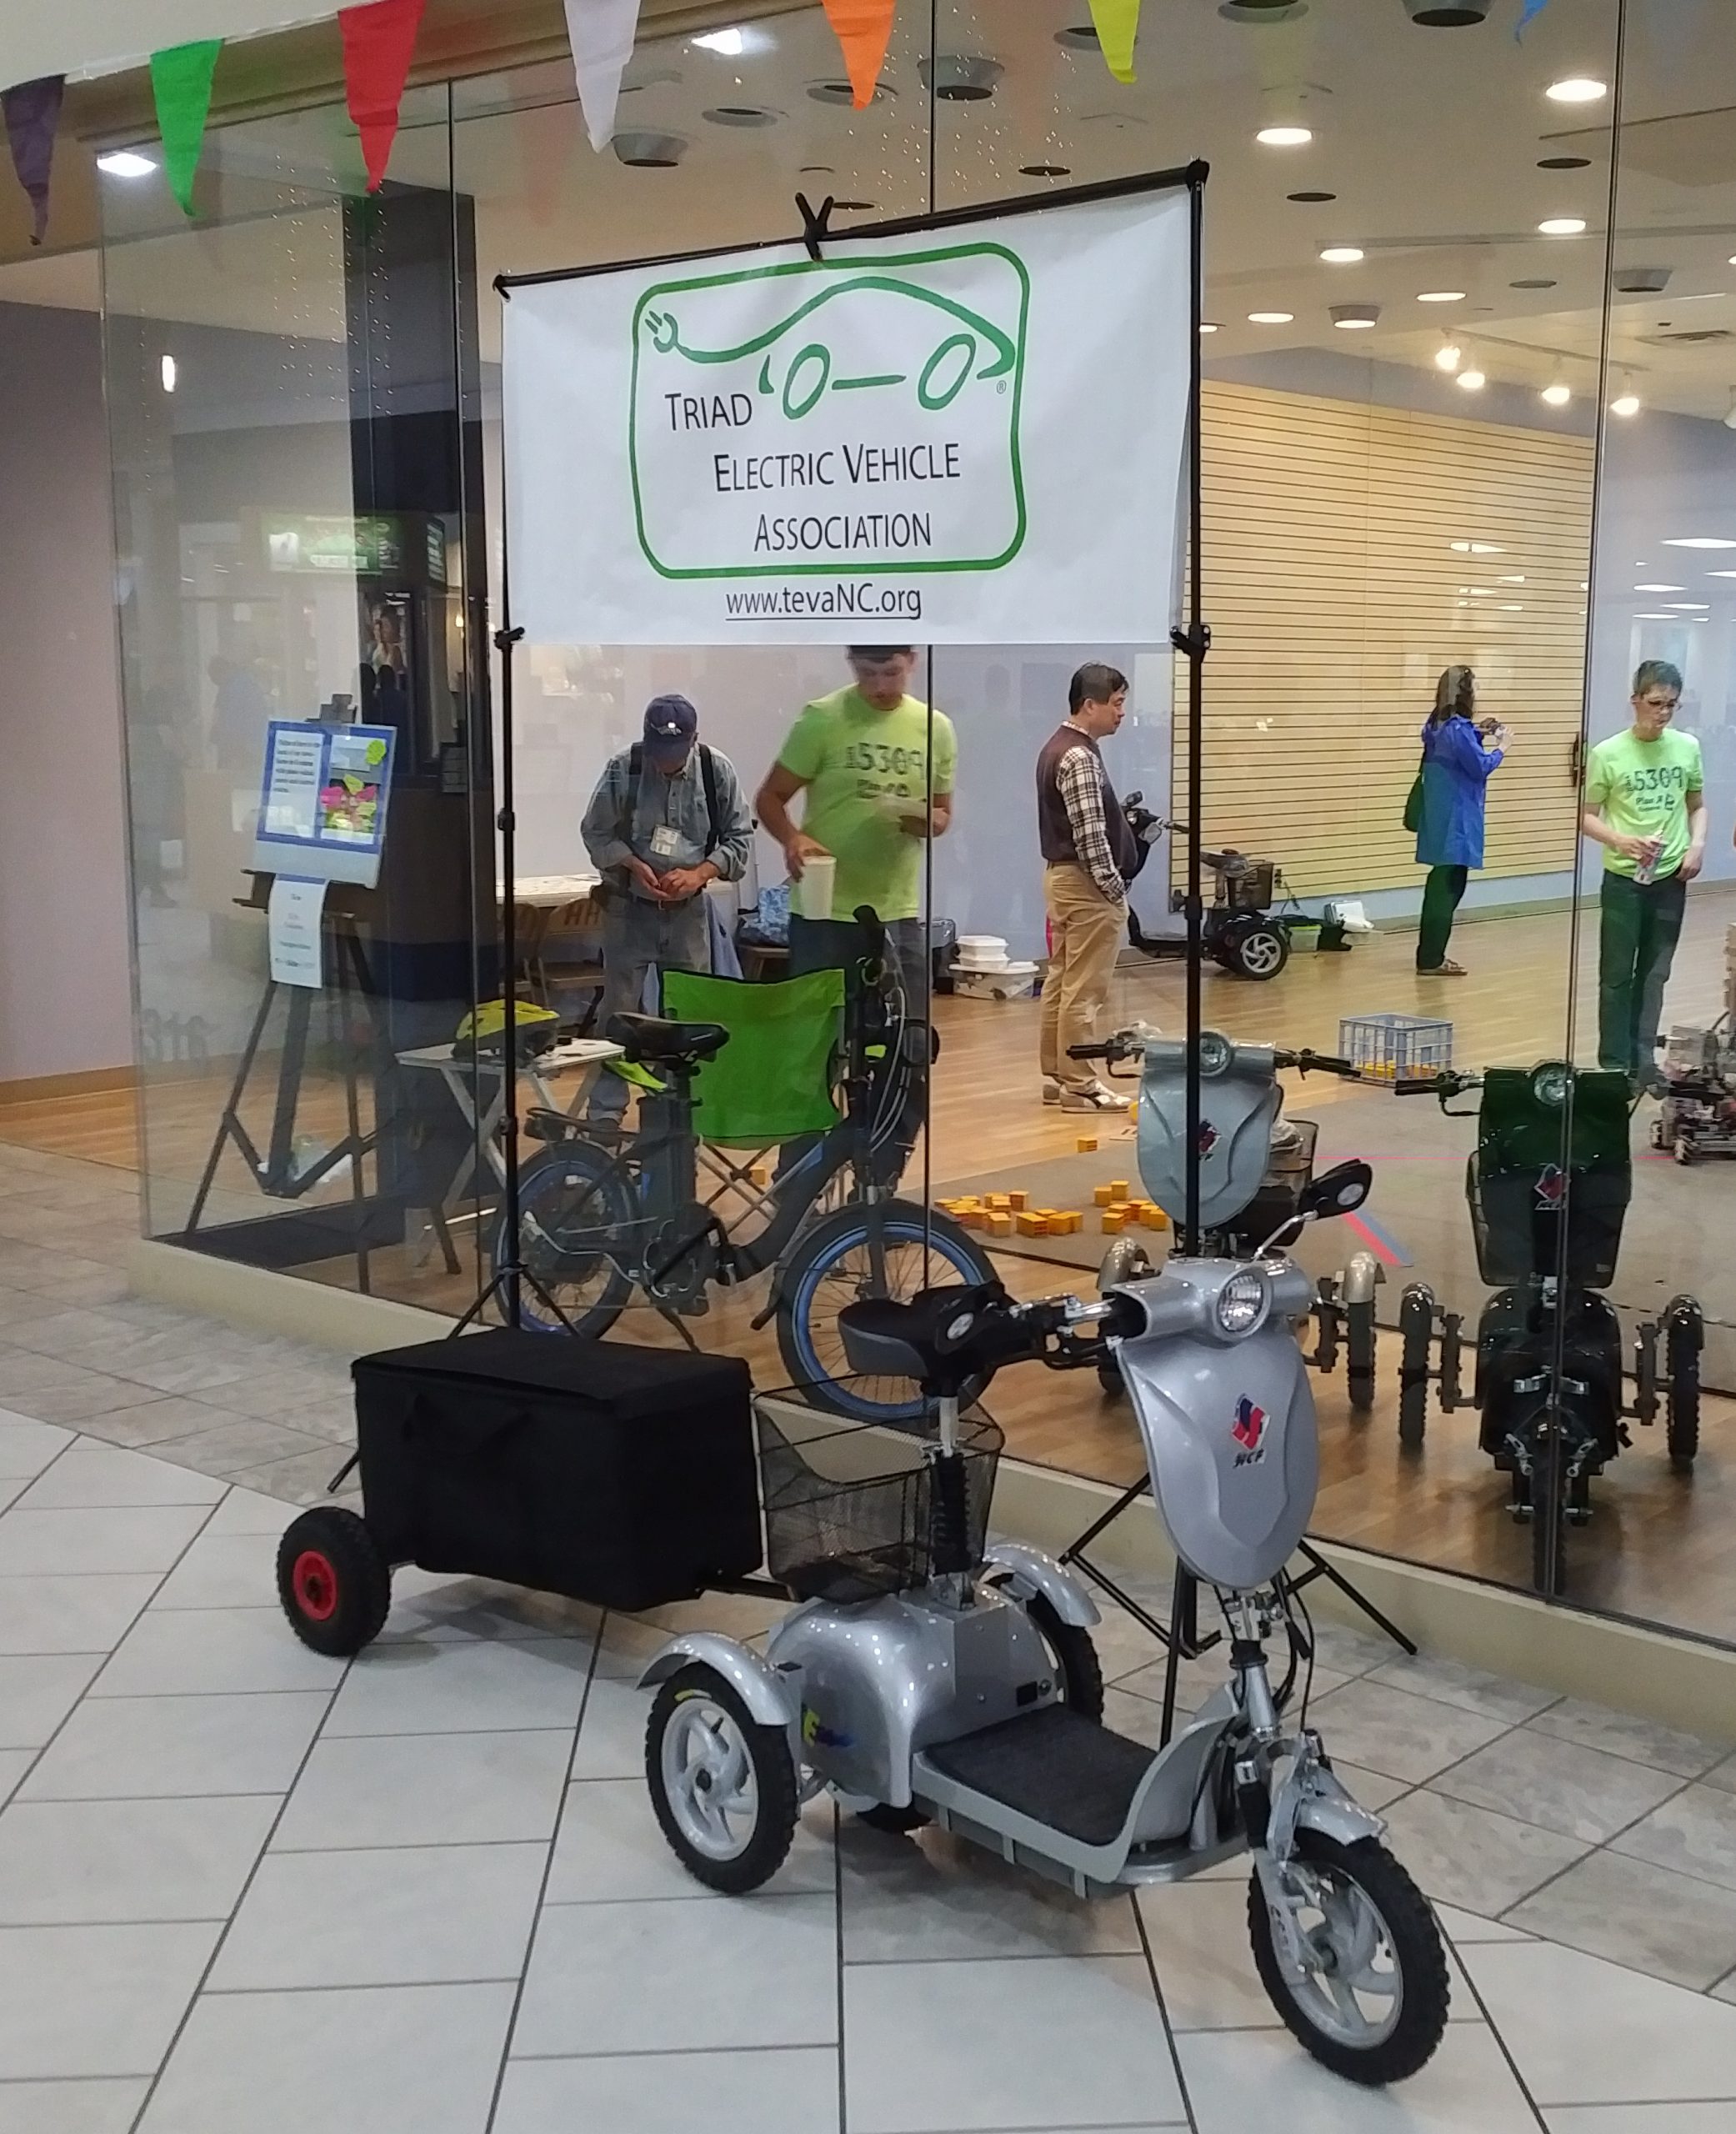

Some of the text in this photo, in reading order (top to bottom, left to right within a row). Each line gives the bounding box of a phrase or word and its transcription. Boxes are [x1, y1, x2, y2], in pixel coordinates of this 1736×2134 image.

[665, 393, 753, 430] TRIAD
[714, 443, 961, 492] ELECTRIC VEHICLE
[754, 513, 932, 552] ASSOCIATION
[726, 584, 921, 620] www.tevaNC.org
[1633, 765, 1683, 792] 5369
